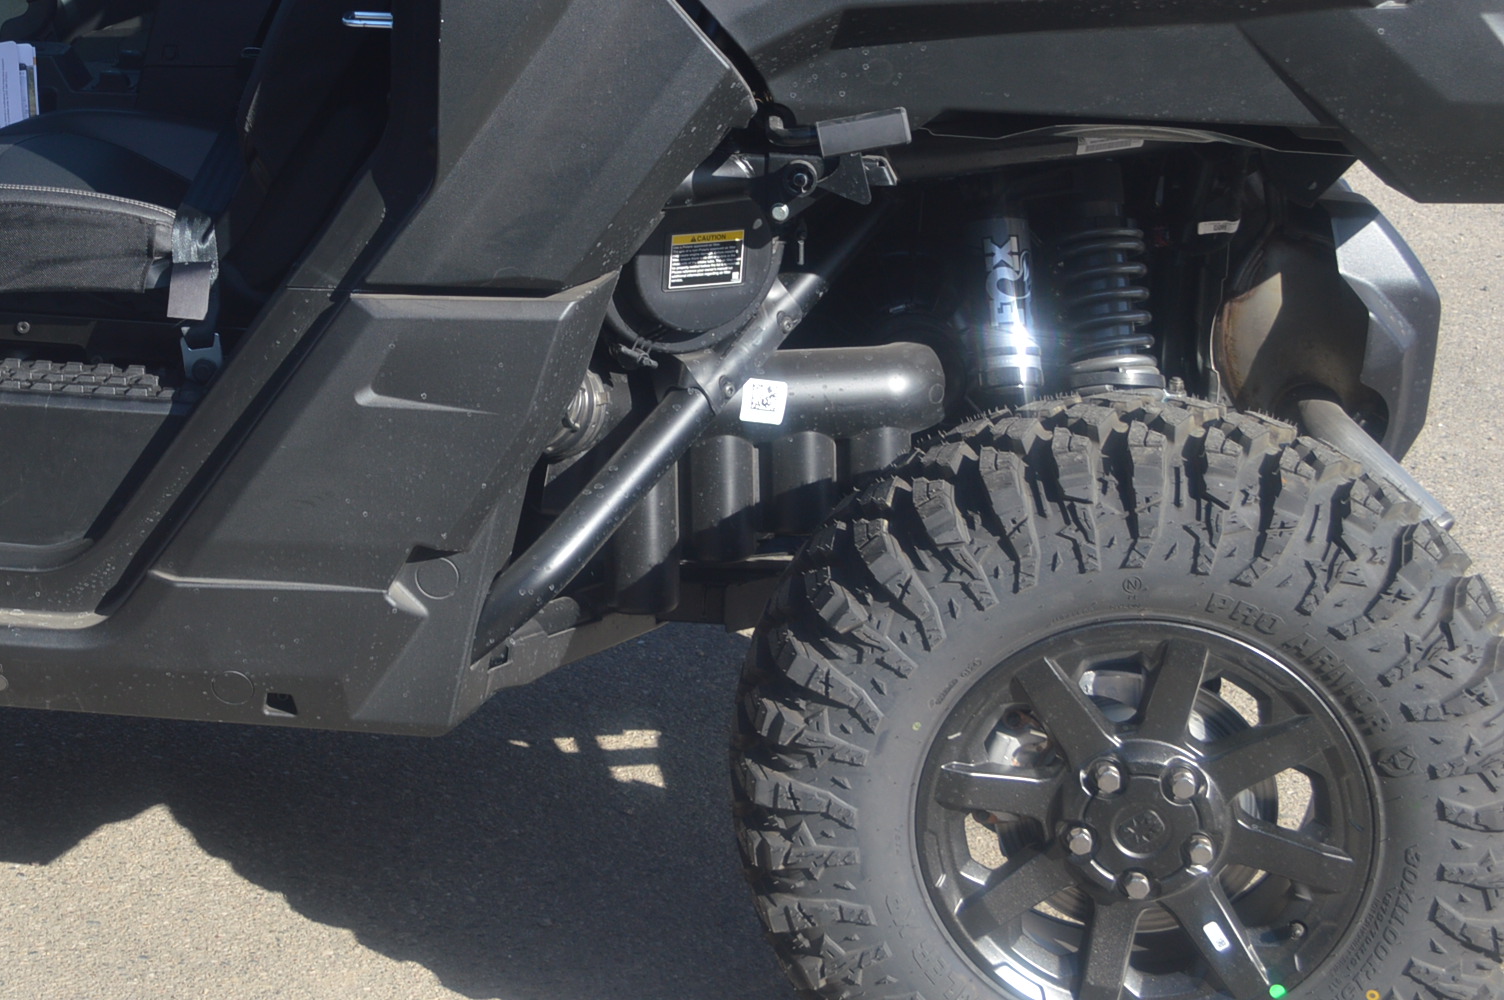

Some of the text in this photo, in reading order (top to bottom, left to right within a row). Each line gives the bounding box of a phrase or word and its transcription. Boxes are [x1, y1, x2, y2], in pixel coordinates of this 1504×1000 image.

[696, 234, 726, 242] CAUTION
[982, 235, 1033, 327] FOX
[1205, 592, 1393, 738] PRO ARMOR
